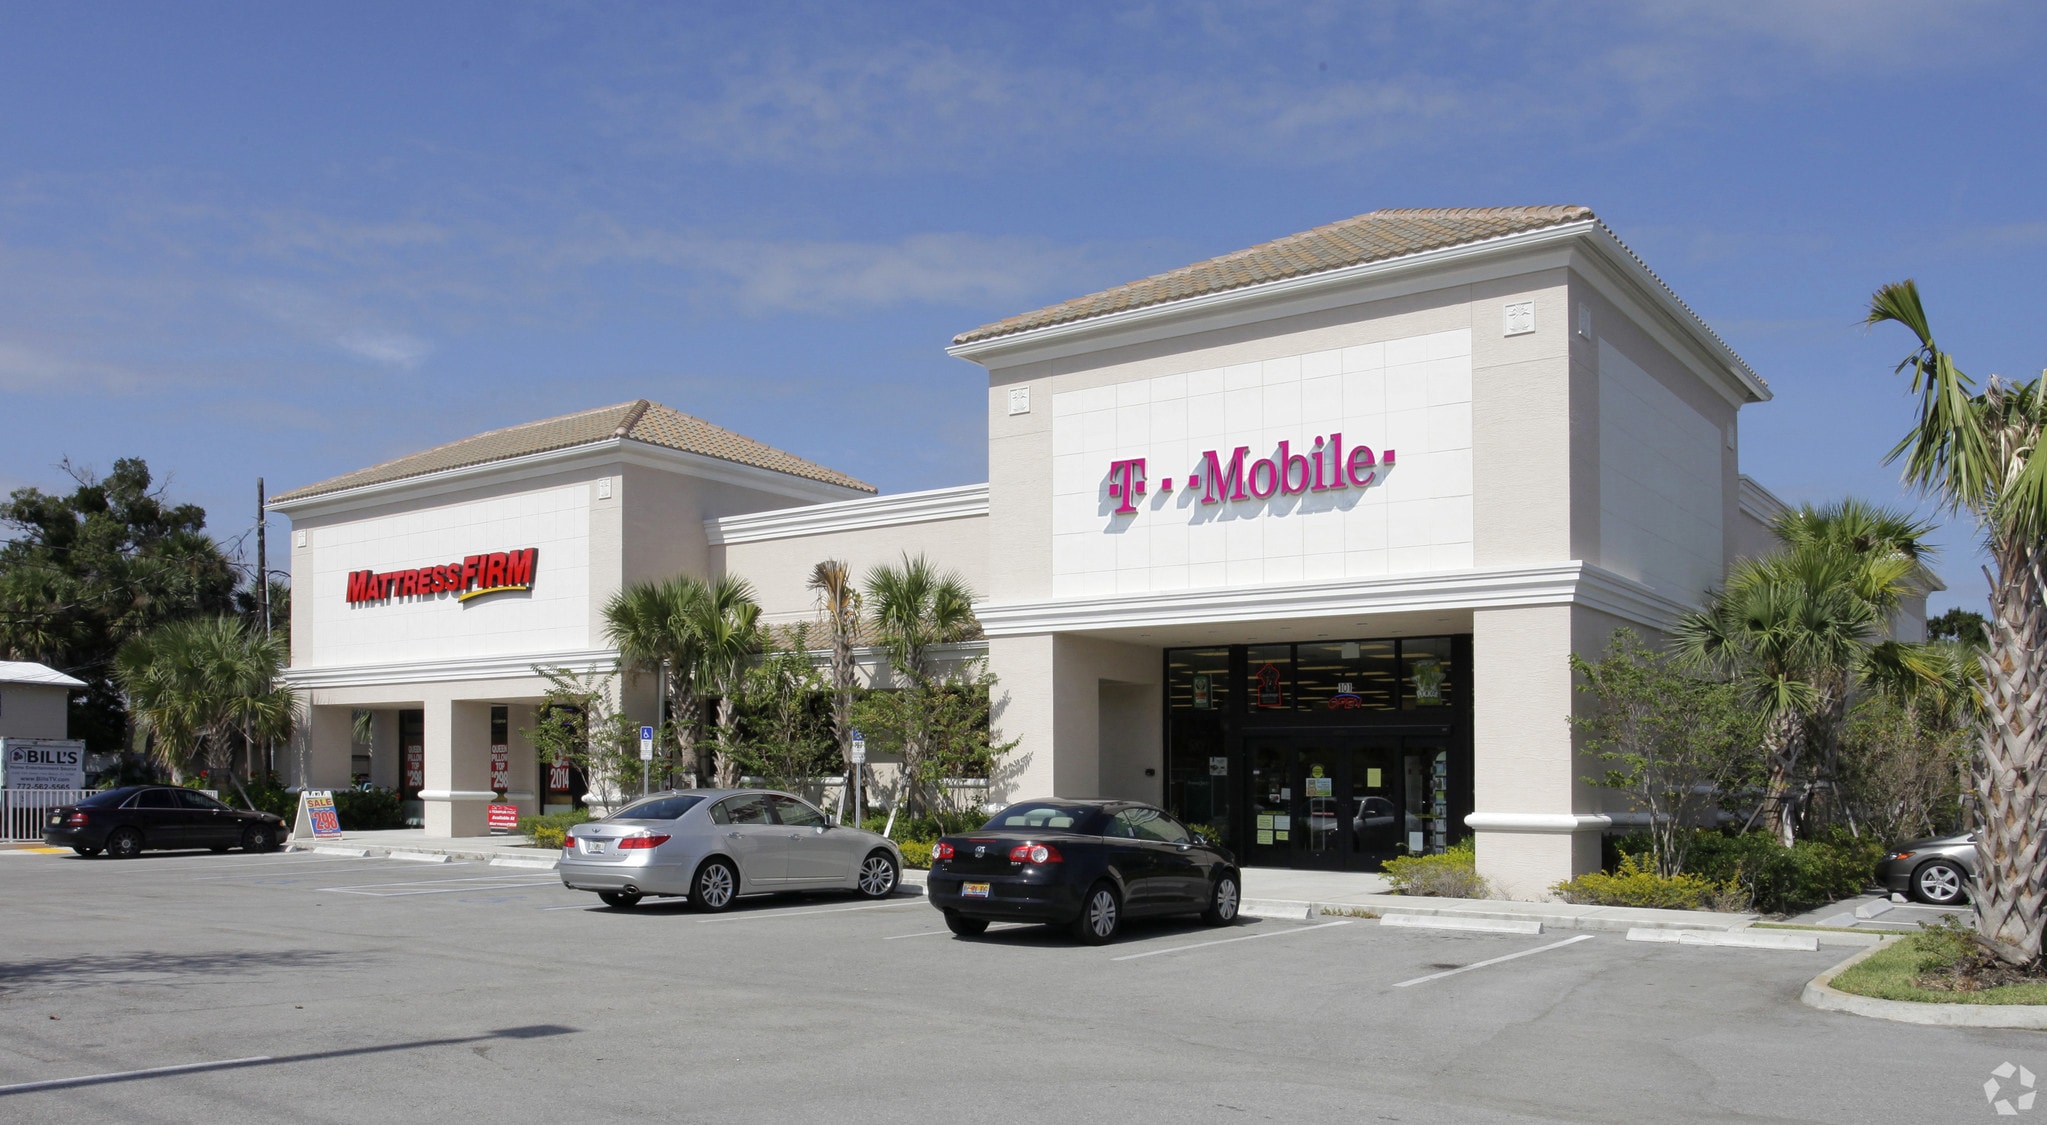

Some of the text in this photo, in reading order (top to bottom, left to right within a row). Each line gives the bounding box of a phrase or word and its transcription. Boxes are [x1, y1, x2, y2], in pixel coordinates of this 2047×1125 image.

[1338, 683, 1352, 693] 101
[1328, 697, 1362, 709] OPEN
[407, 745, 422, 753] QUEEN
[491, 745, 507, 753] QUEEN
[27, 750, 77, 764] BILL'S
[411, 762, 419, 770] TOP
[491, 771, 508, 788] $298
[550, 768, 569, 788] 2014
[307, 798, 332, 807] SALE
